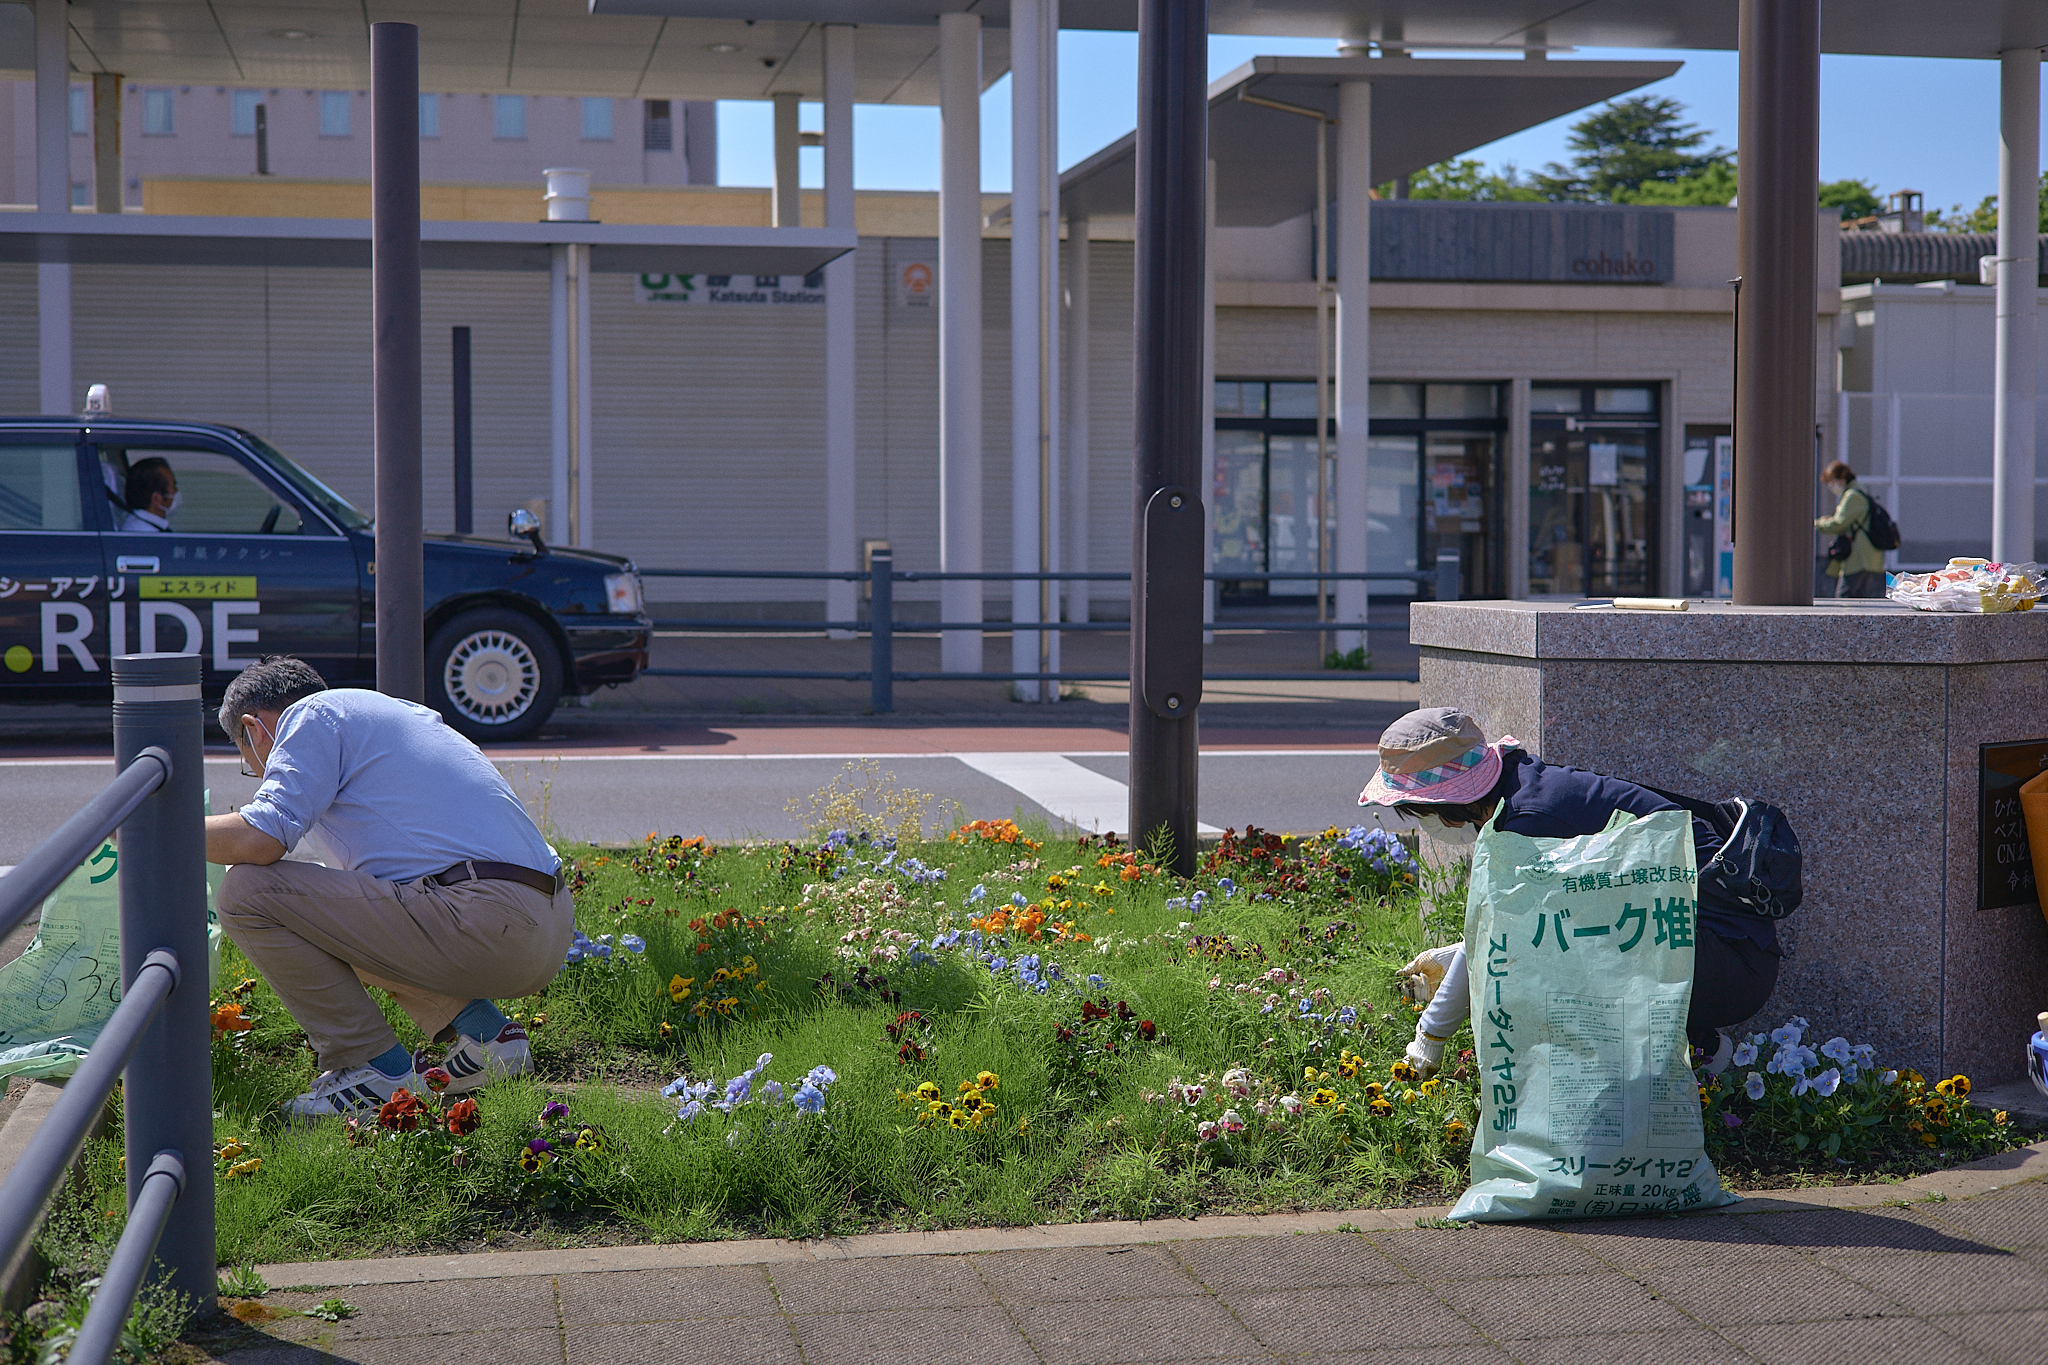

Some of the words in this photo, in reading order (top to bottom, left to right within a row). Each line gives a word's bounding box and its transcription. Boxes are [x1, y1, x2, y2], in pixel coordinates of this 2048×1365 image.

[1572, 250, 1656, 276] cohako
[709, 290, 767, 303] Katsuta
[772, 290, 826, 303] Station
[159, 580, 236, 594] エスライド
[1994, 798, 2022, 818] ひた
[1562, 865, 1697, 894] 有機質土壌改良材
[1530, 896, 1698, 954] バーク堆
[1487, 933, 1518, 1133] スリーダイヤ2号
[1548, 1155, 1699, 1179] スリーダイヤ2
[1594, 1183, 1636, 1197] 正味量
[1641, 1184, 1678, 1198] 20kg
[1550, 1197, 1577, 1208] 製造
